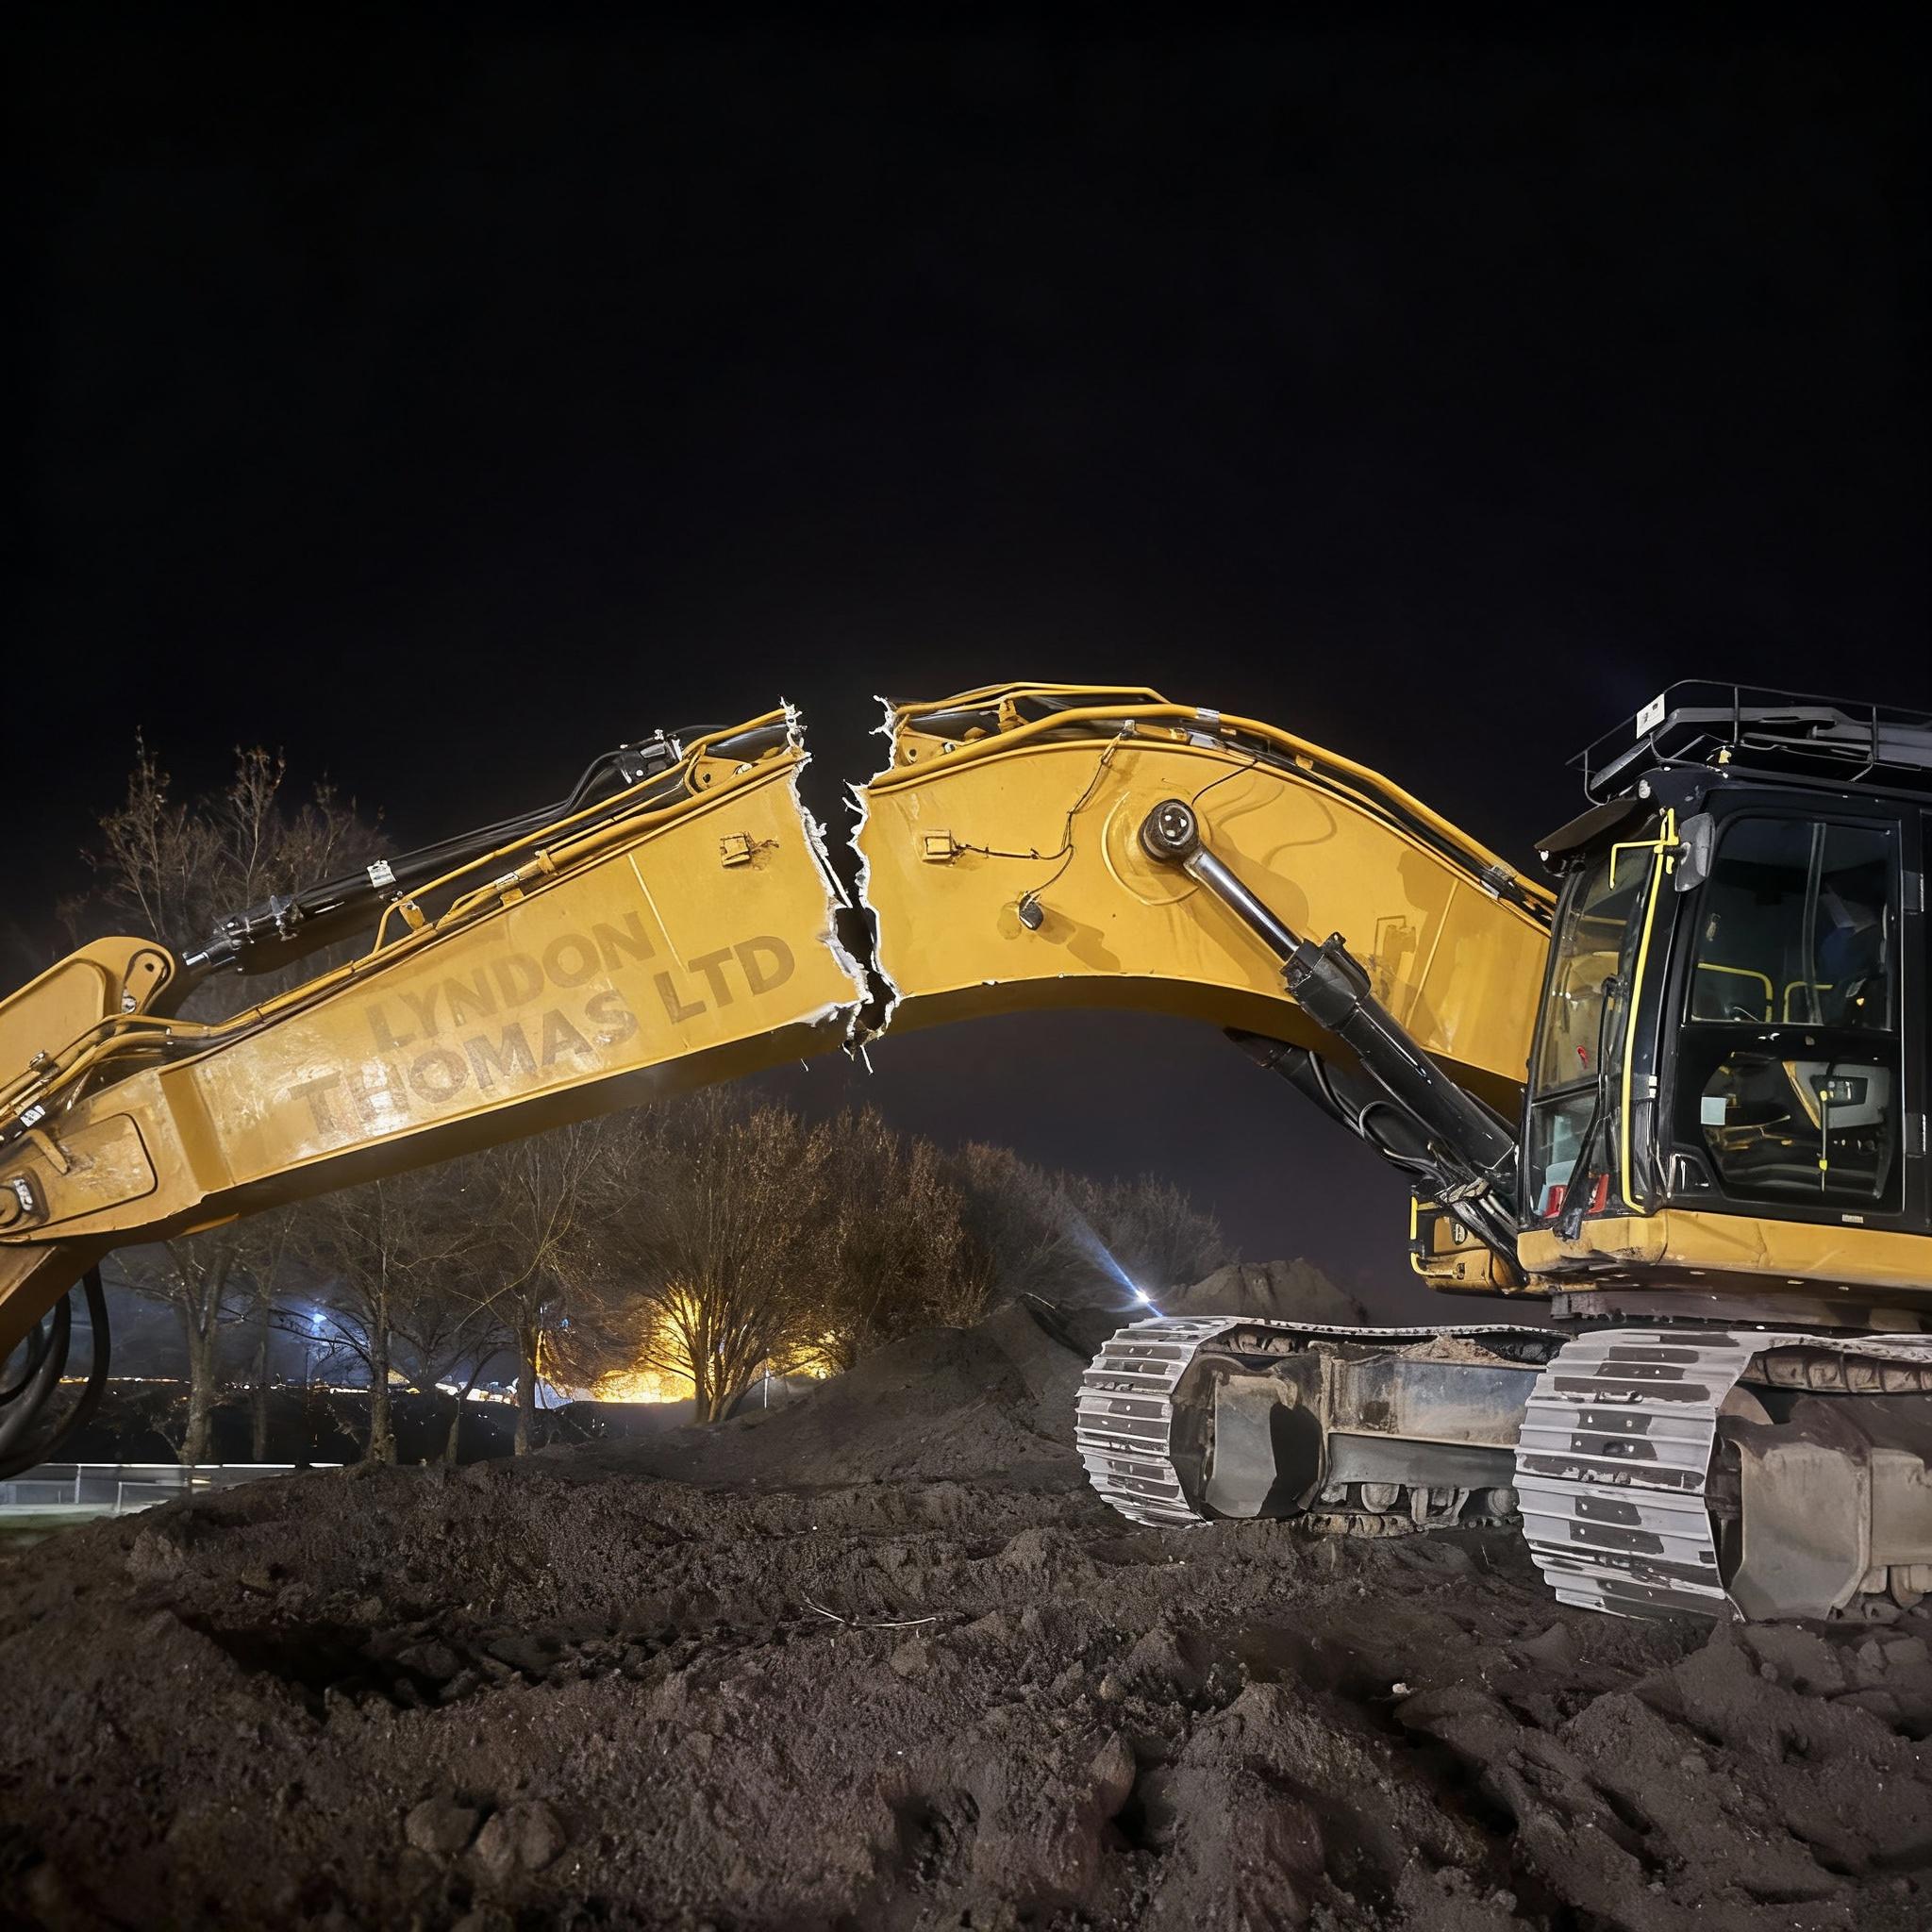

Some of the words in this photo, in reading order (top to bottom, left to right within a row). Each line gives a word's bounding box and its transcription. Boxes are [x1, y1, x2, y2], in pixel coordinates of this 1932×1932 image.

[288, 990, 639, 1136] THOMAS
[656, 936, 795, 1024] LTD
[365, 912, 655, 1054] LYNDON
